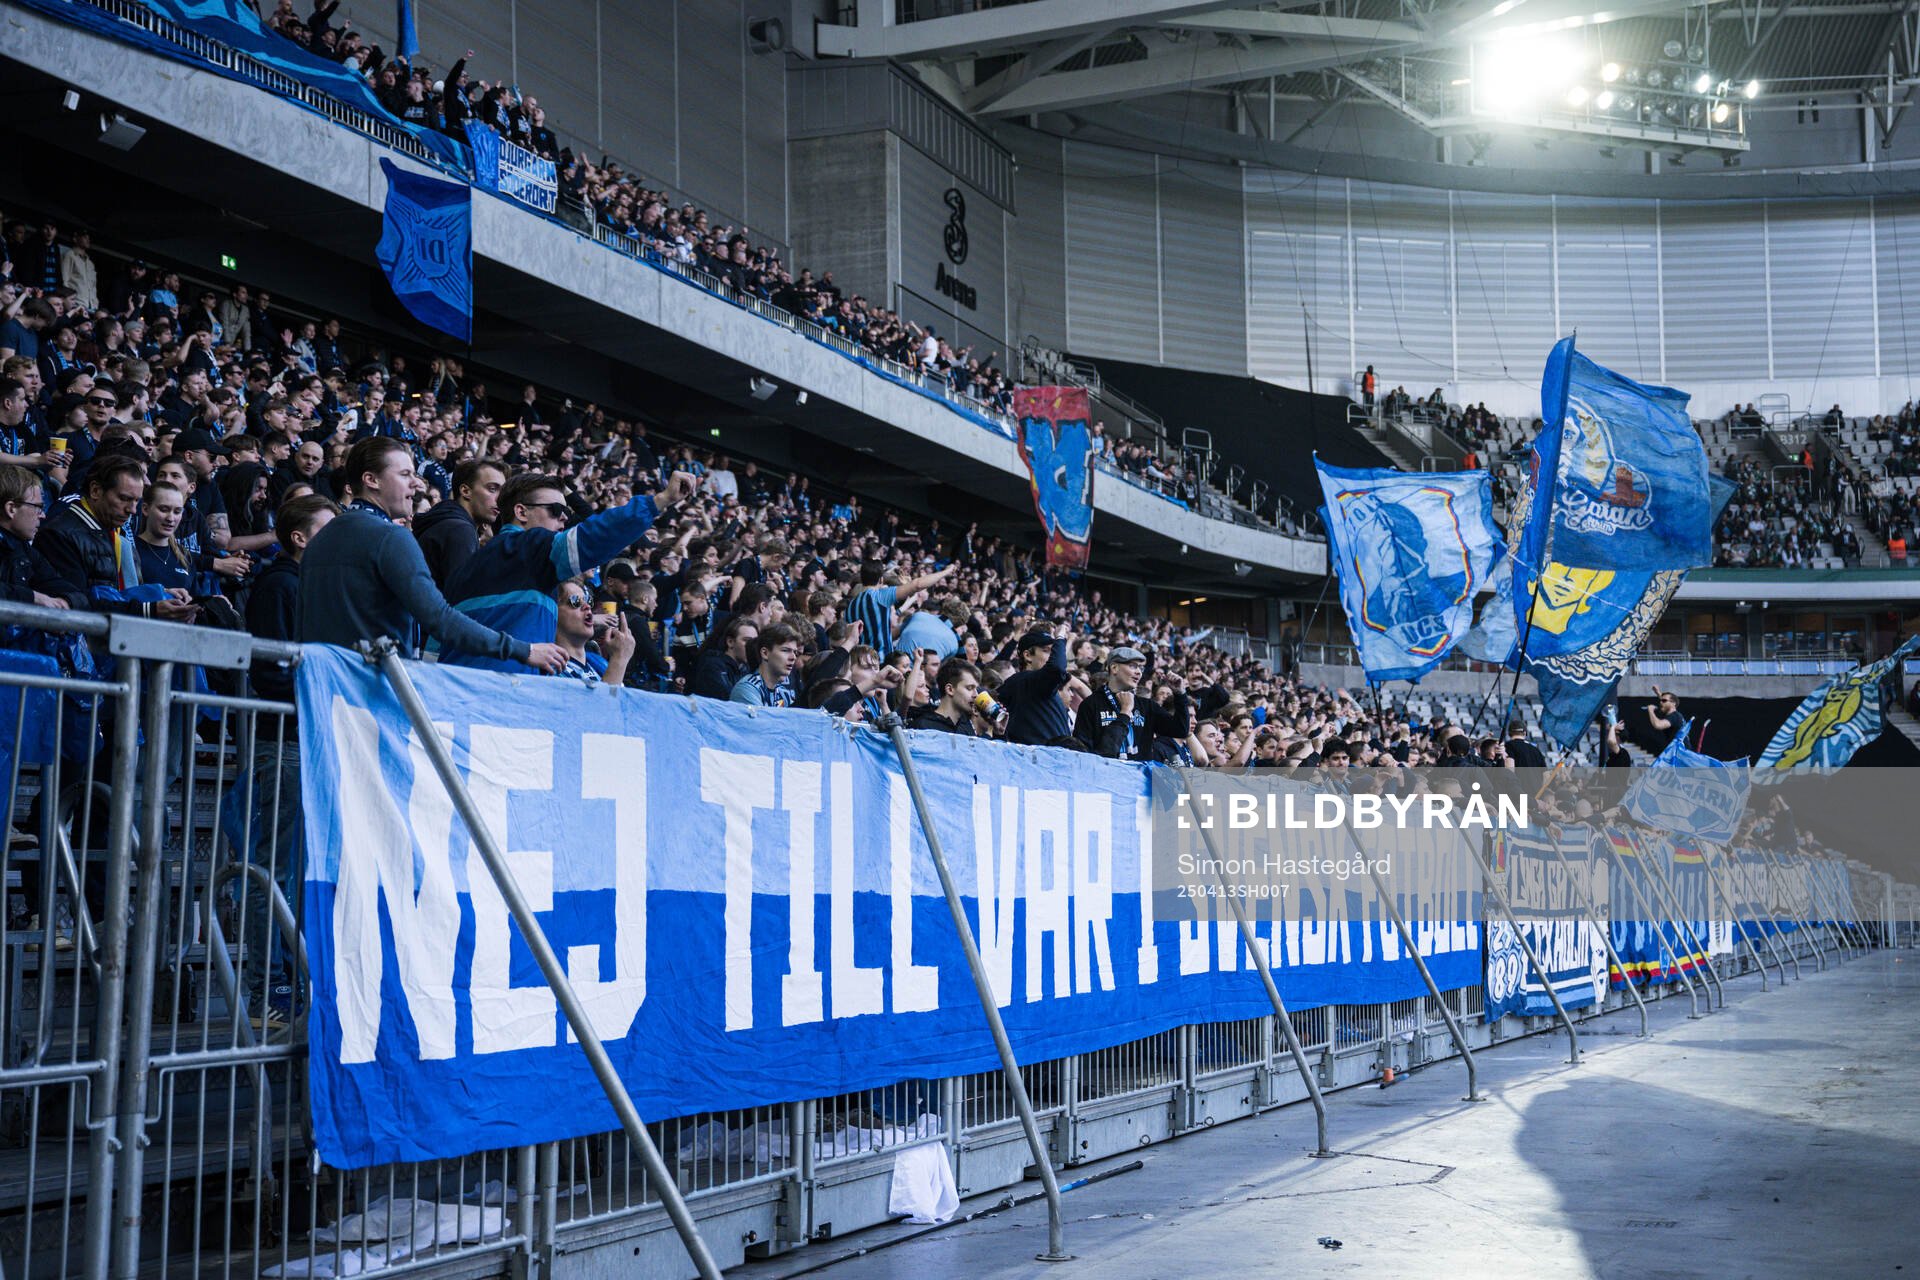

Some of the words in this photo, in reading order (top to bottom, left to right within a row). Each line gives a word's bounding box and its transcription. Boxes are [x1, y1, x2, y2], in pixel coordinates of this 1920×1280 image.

[935, 261, 977, 312] Arena
[1780, 433, 1808, 445] B312
[331, 694, 647, 1064] NEJ
[700, 747, 940, 1033] TILL
[972, 783, 1116, 1009] VAR
[1136, 795, 1159, 986] I
[1178, 797, 1352, 977] SVENSK
[1360, 823, 1479, 963] FOTBOLL
